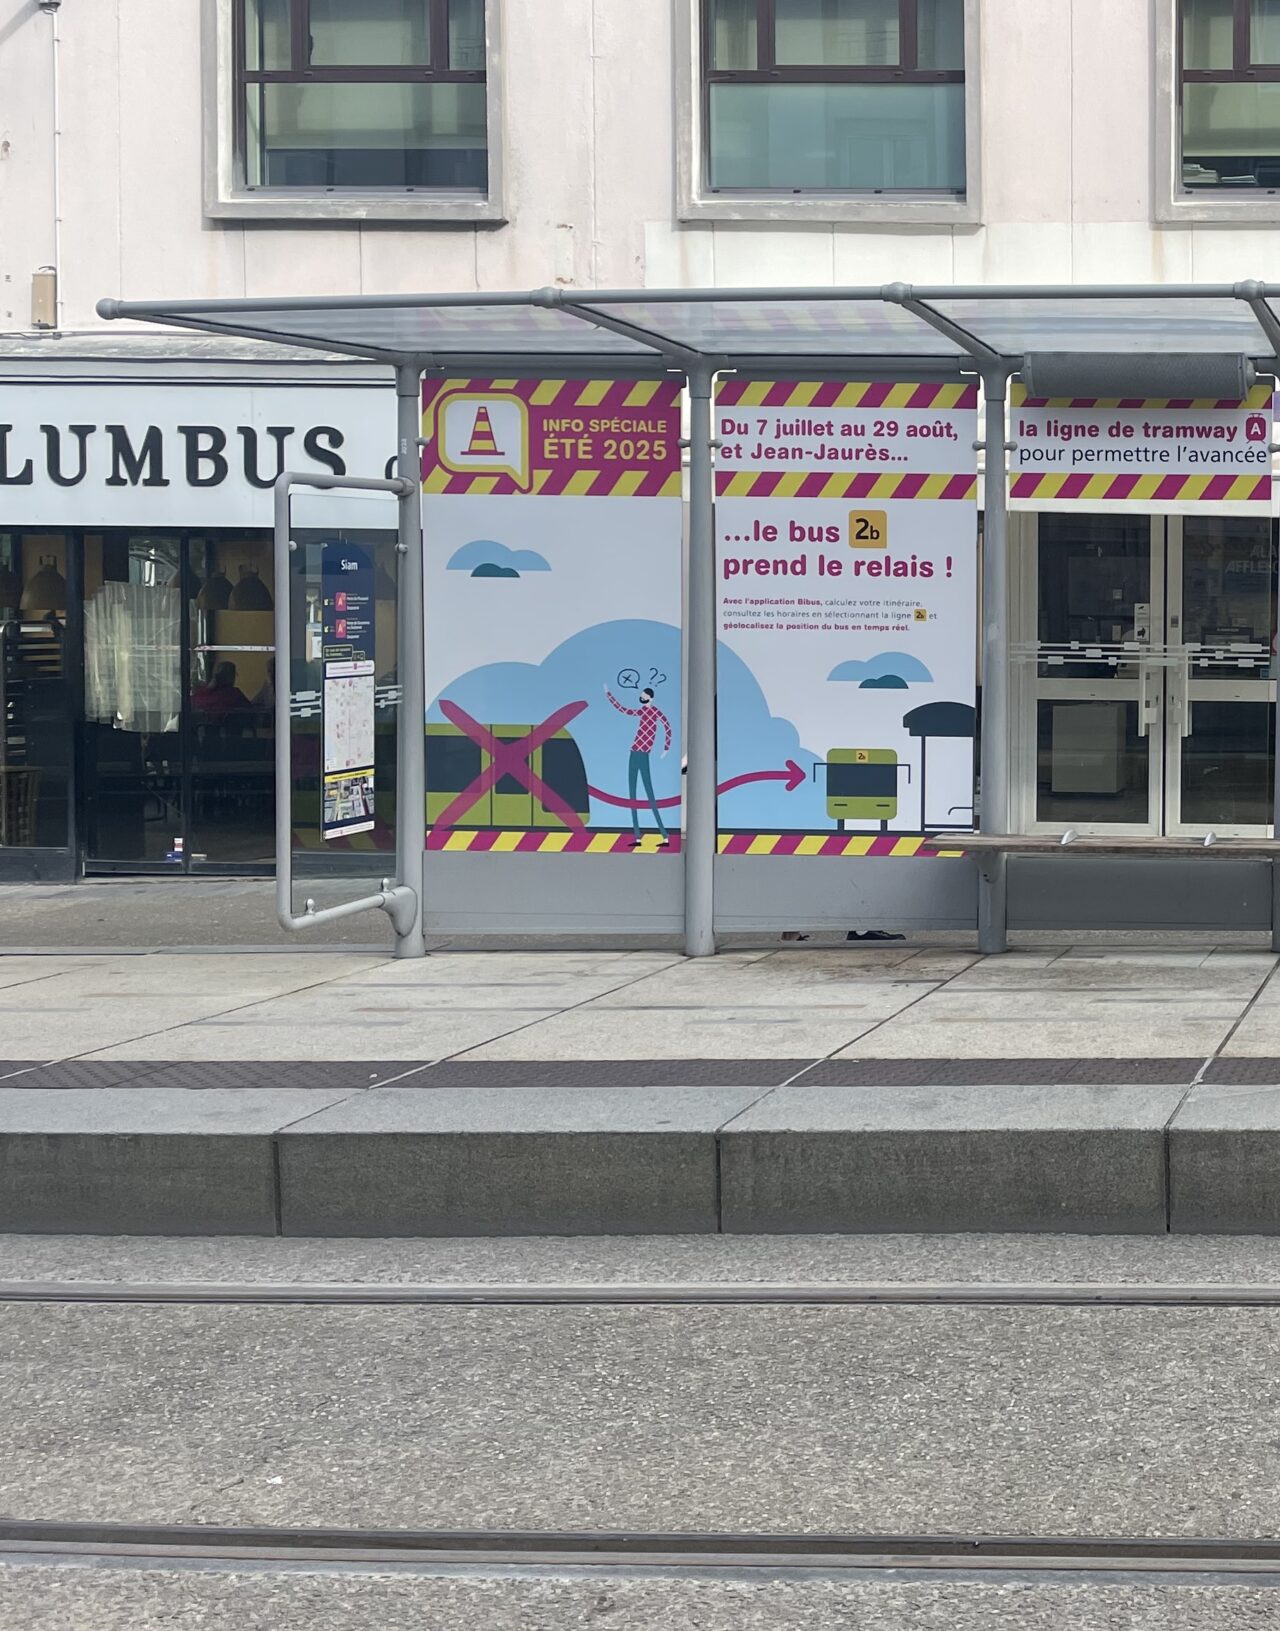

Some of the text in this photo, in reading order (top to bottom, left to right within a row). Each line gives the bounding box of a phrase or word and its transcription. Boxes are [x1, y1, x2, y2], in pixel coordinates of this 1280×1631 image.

[543, 417, 667, 433] INFO SPÉCIALE
[720, 418, 959, 442] Du 7 juillet au 29 août,
[1019, 420, 1262, 442] la ligne de tramway A
[543, 433, 667, 461] ÉTÉ 2025
[720, 443, 909, 462] et Jean-Jaurès...
[1019, 445, 1267, 465] pour permettre l'avancée
[724, 517, 880, 543] ...le bus 2b
[341, 559, 358, 571] Siam
[723, 554, 953, 580] prend le relais !
[744, 597, 795, 607] l'application
[797, 598, 823, 607] Bibus,
[777, 610, 810, 618] horaires
[824, 610, 879, 619] sélectionnant
[881, 611, 889, 619] la
[891, 611, 911, 621] ligne
[723, 622, 774, 631] géolocalisez
[776, 622, 784, 630] la
[786, 623, 819, 632] position
[834, 623, 849, 631] bus
[864, 624, 889, 633] temps
[892, 623, 910, 631] réel.
